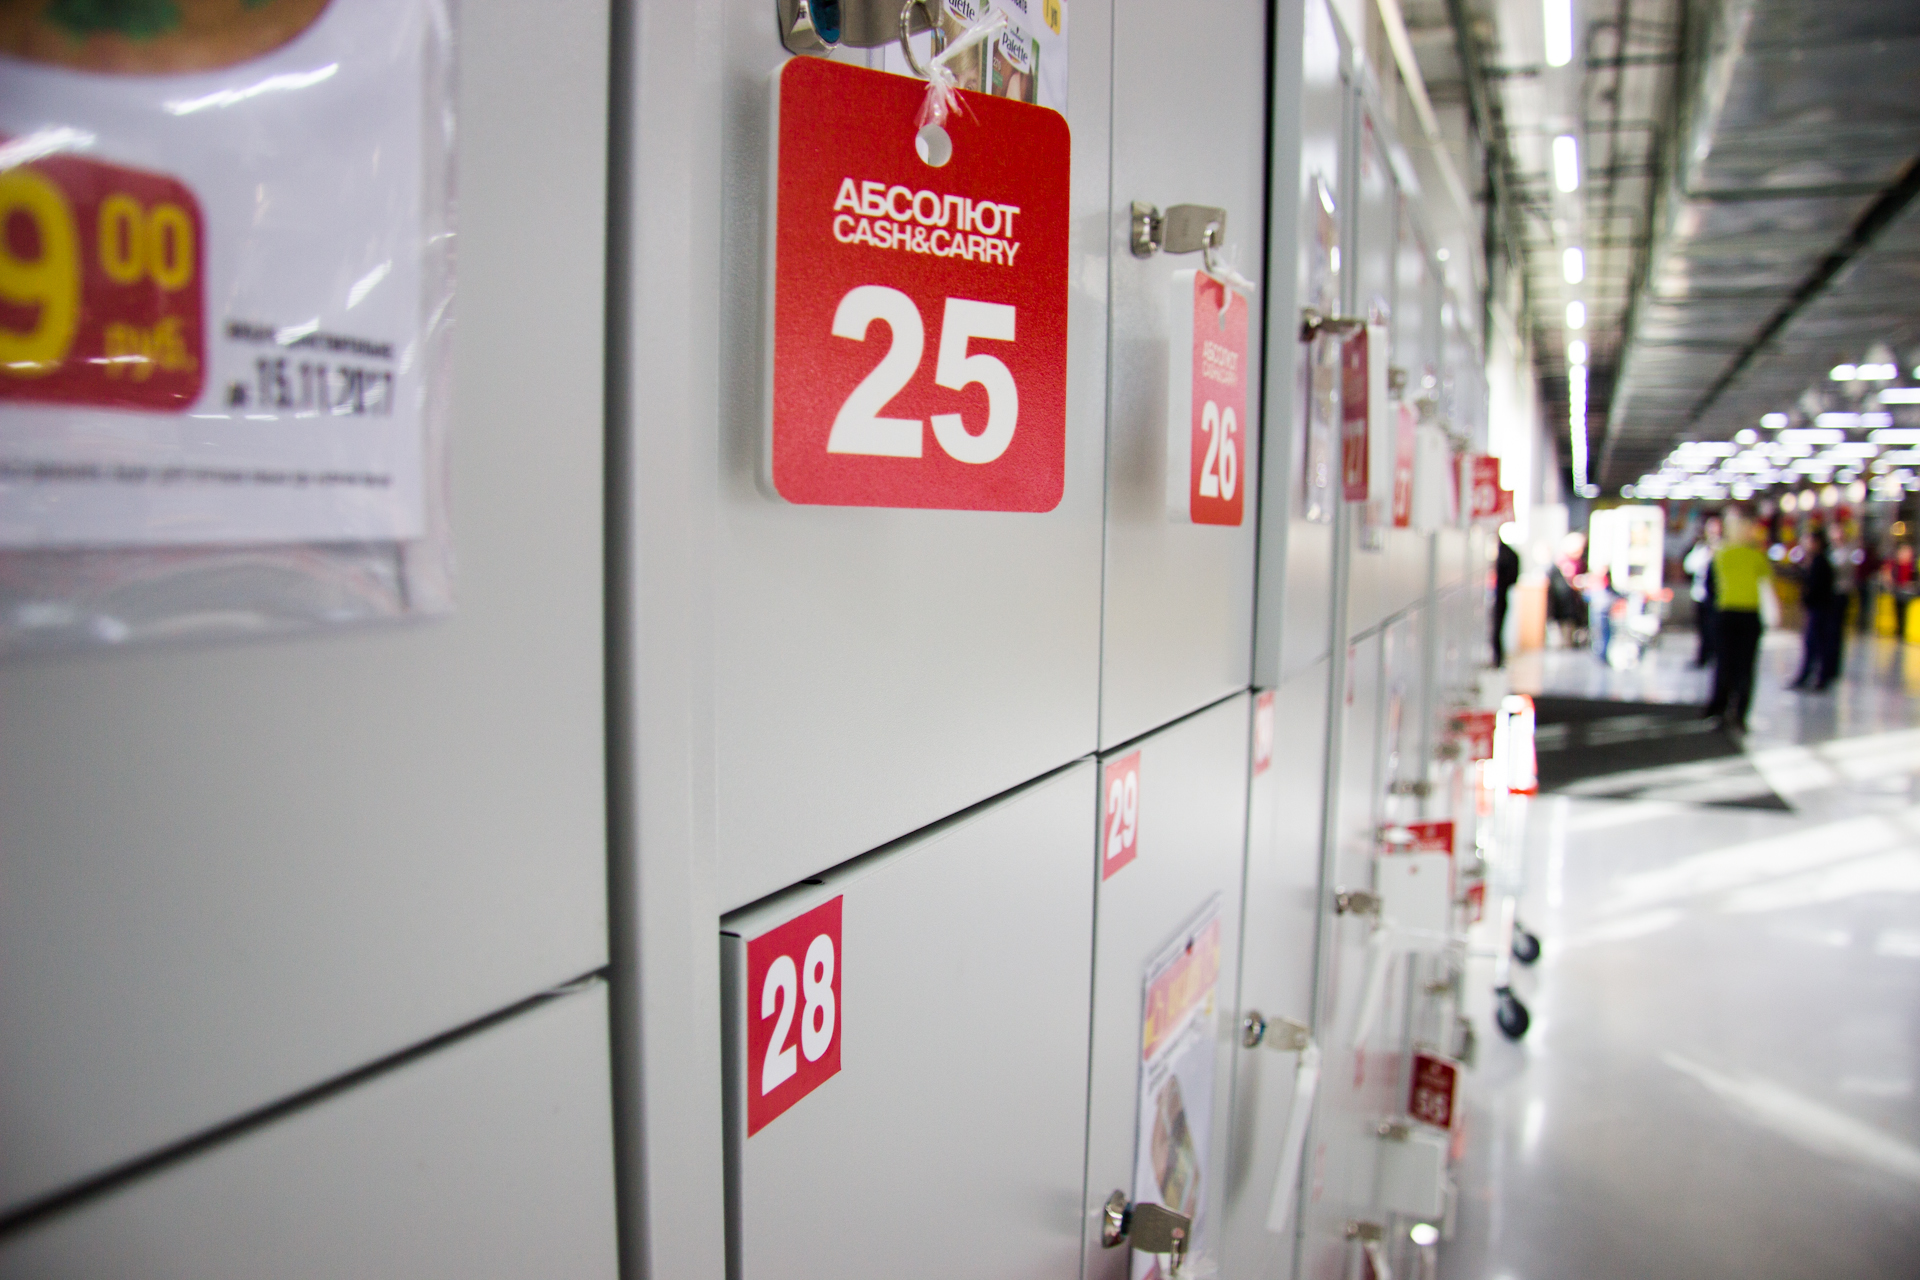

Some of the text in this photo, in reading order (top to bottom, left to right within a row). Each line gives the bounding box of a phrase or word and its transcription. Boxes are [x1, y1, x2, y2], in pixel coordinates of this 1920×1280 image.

[1002, 31, 1029, 64] Palette
[832, 214, 1021, 267] CASH&CARRY
[833, 177, 1021, 238] АБСОЛЮТ
[0, 168, 194, 376] 9 00
[826, 284, 1019, 464] 25
[1199, 400, 1238, 501] 26
[1106, 770, 1138, 861] 29
[761, 933, 836, 1097] 28
